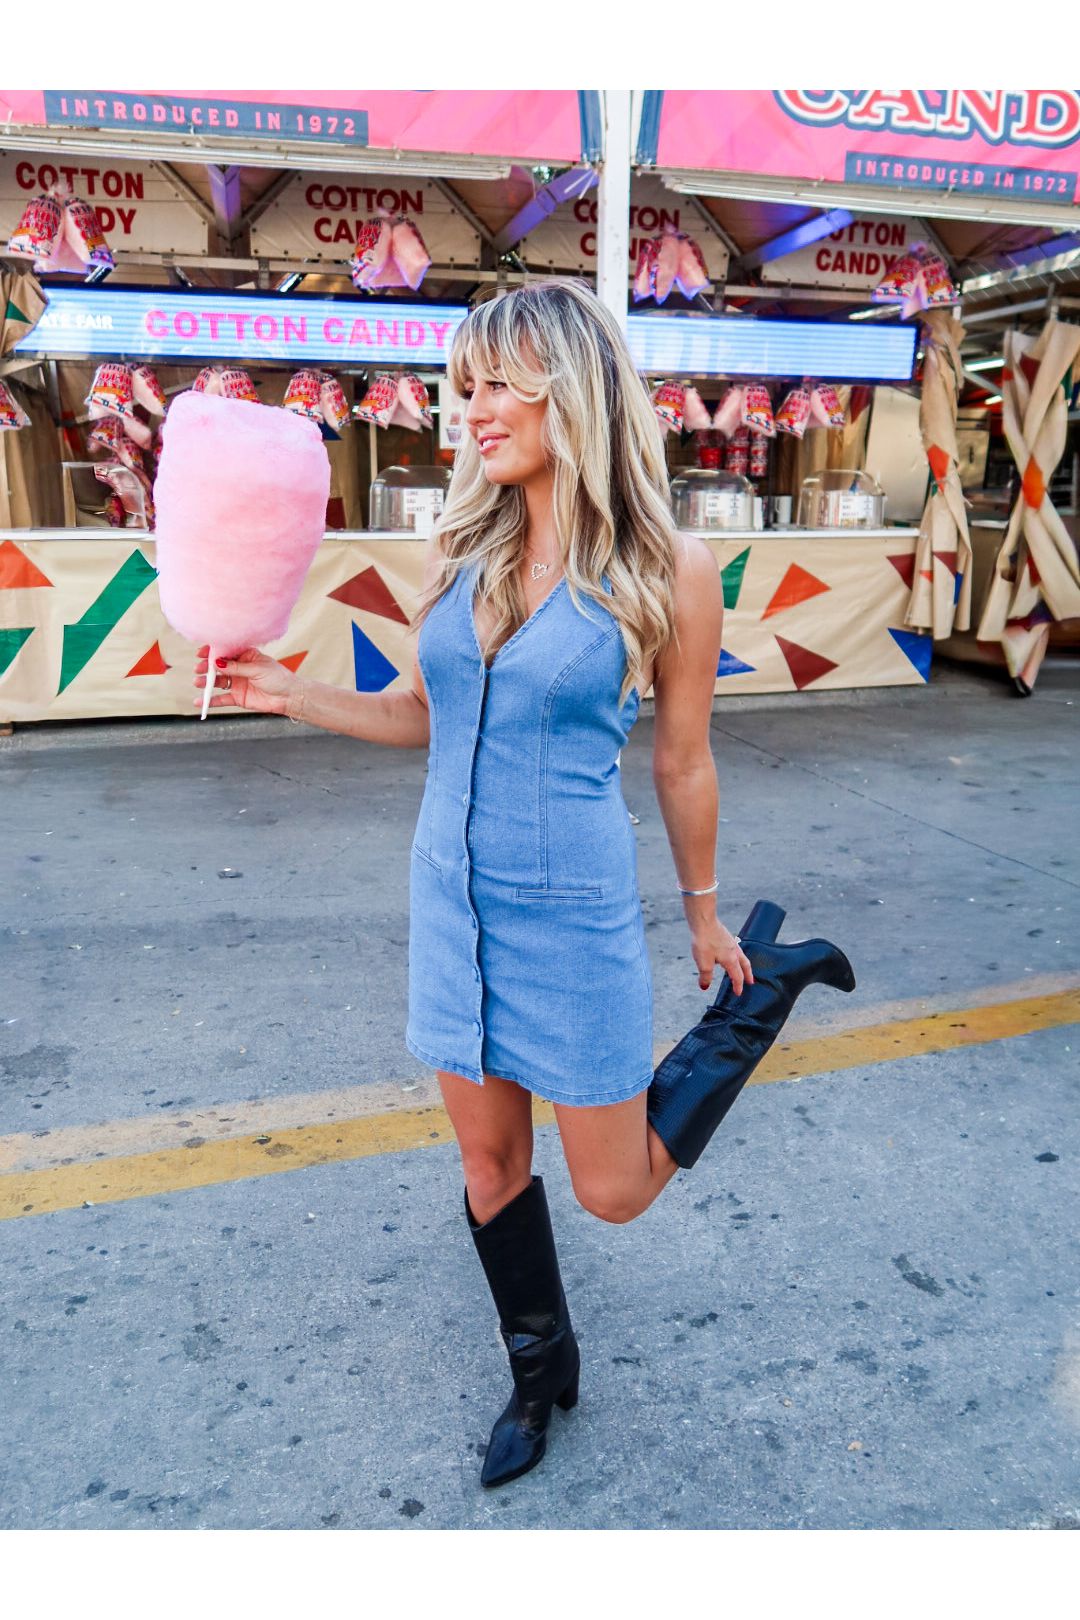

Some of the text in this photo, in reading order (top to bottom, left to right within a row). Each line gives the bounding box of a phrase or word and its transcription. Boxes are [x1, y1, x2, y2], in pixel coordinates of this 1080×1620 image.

[60, 98, 356, 136] INTRODUCED IN 1972
[15, 162, 144, 199] COTTON
[856, 160, 1067, 192] INTRODUCED IN 1972
[305, 184, 424, 214] COTTON
[574, 198, 680, 232] CTON
[816, 248, 898, 276] CANDY
[76, 313, 114, 330] FAIR
[144, 310, 451, 348] COTTON CANDY
